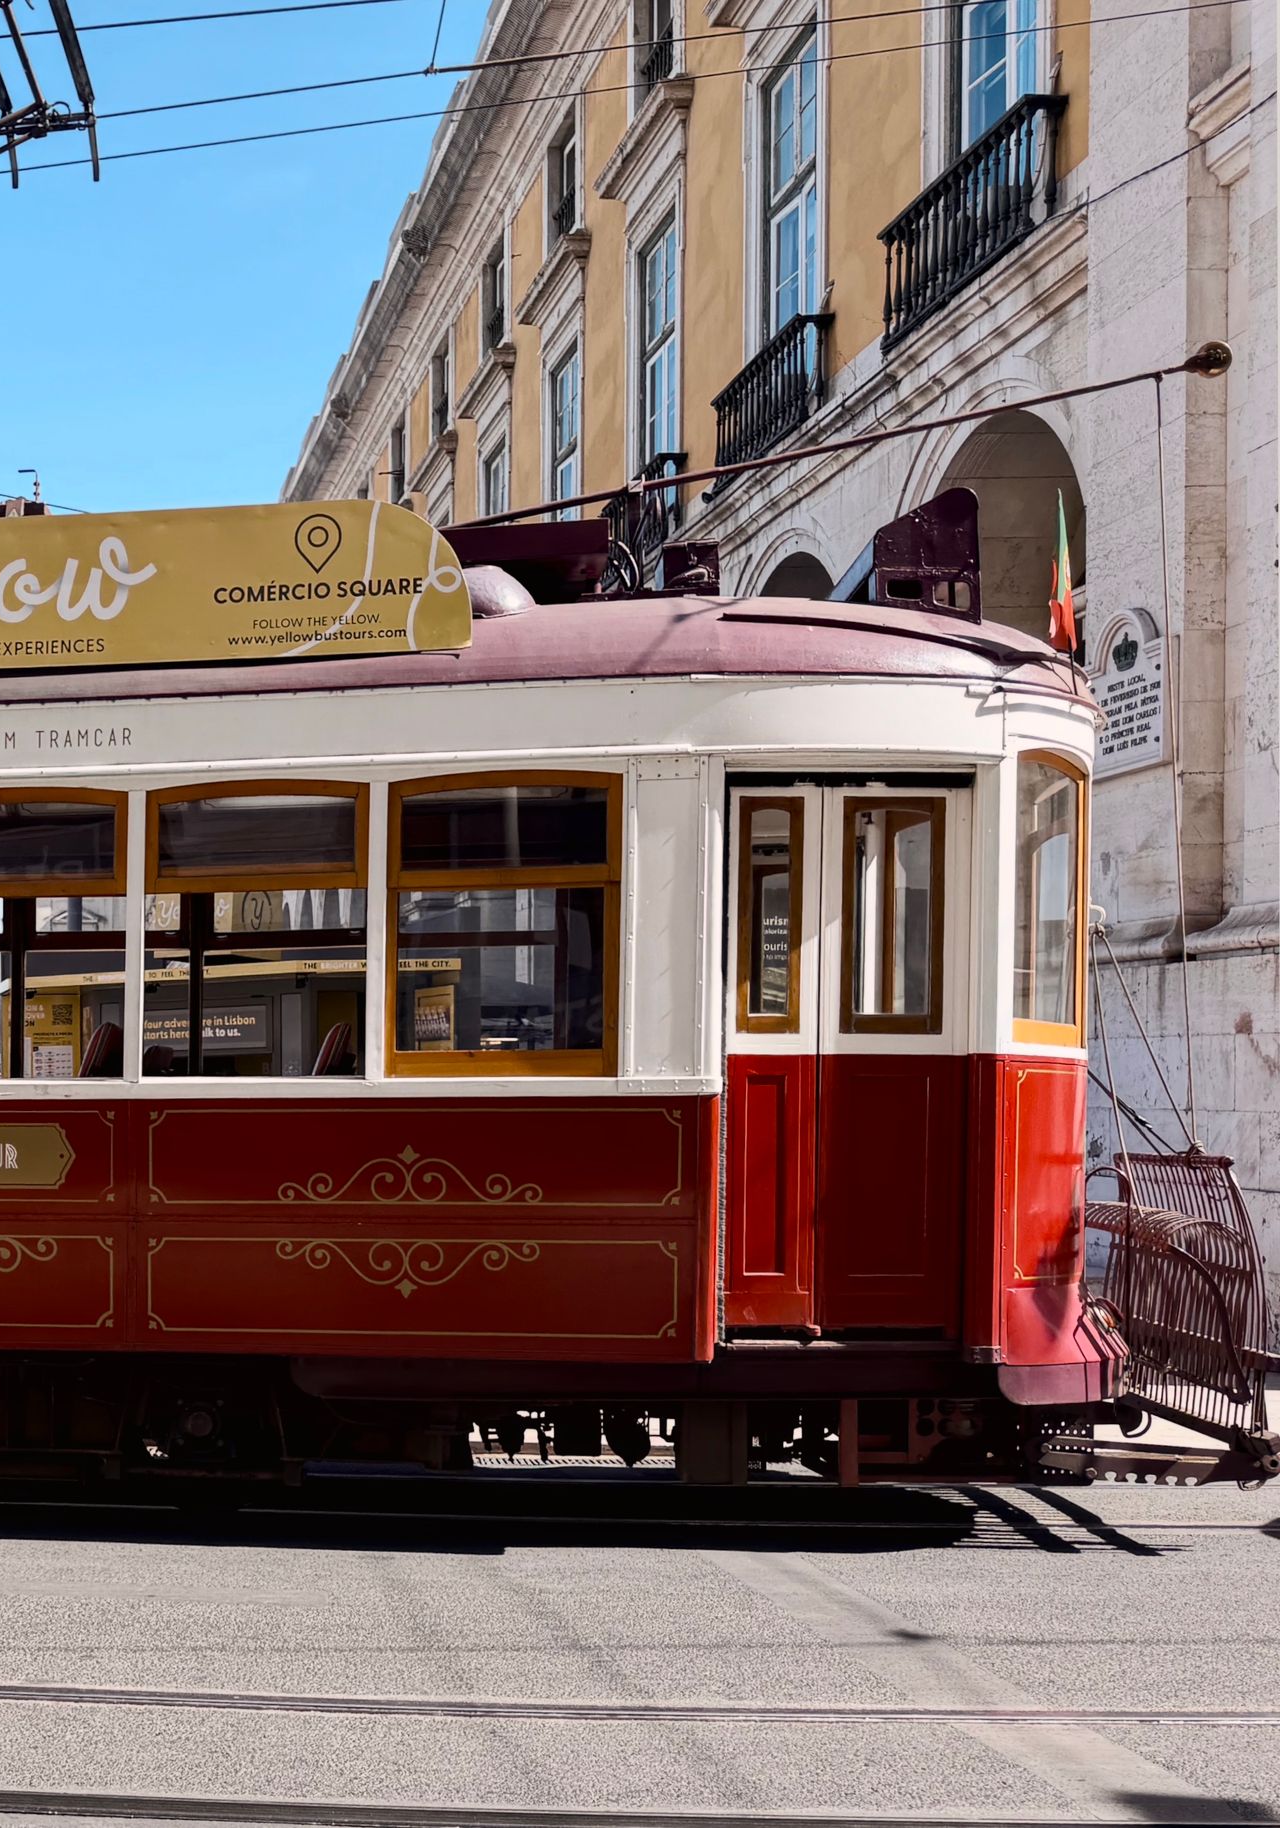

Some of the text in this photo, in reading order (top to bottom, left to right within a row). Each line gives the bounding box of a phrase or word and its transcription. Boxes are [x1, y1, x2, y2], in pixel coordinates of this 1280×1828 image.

[214, 578, 423, 604] COMÉRCIO SQUARE
[253, 614, 381, 629] FOLLOW THE YELLOW.
[228, 629, 406, 645] www.yellowbustours.com
[1136, 707, 1157, 720] CARLOS
[1137, 722, 1151, 733] REAL
[36, 728, 133, 748] TRAMCAR
[415, 960, 429, 968] THE
[214, 1016, 223, 1026] in
[225, 1015, 255, 1025] Lisbon
[216, 1028, 226, 1037] to
